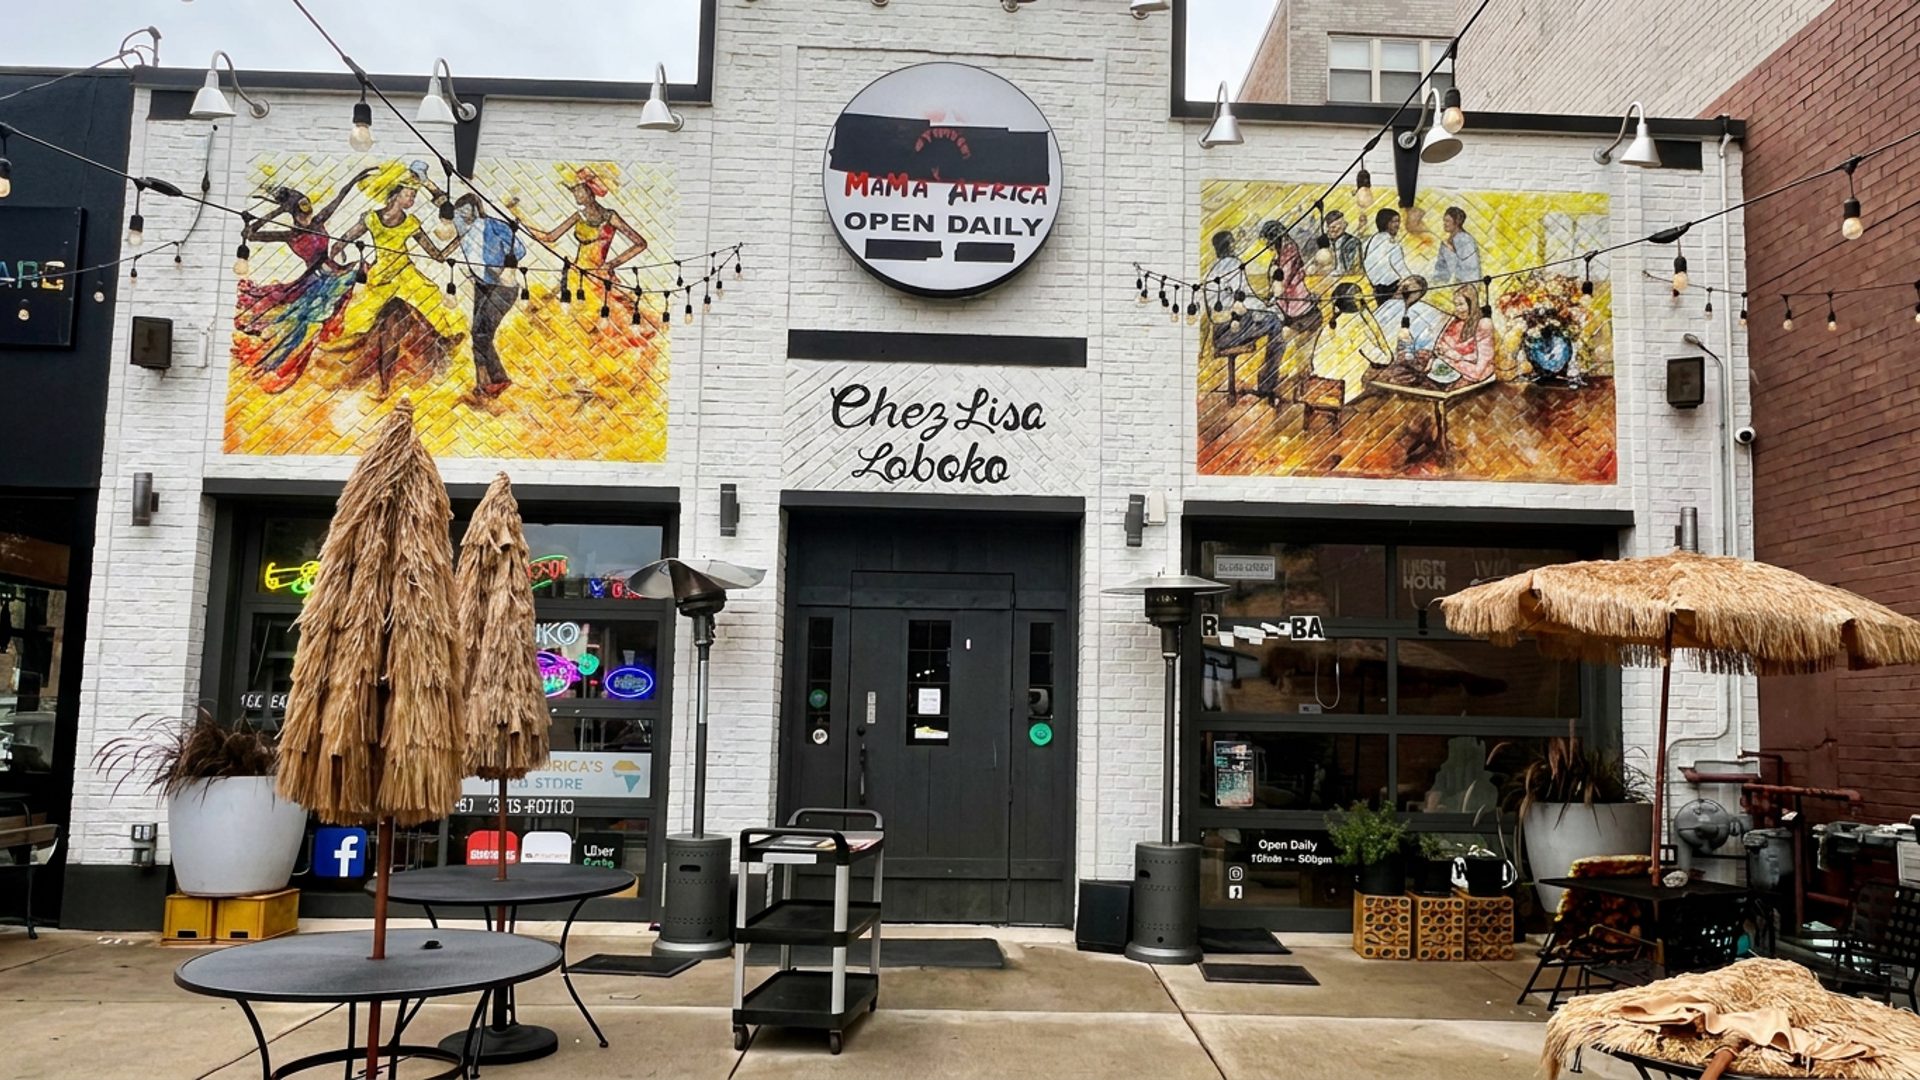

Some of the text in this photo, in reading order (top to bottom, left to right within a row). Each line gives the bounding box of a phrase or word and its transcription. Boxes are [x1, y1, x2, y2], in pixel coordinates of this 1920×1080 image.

[947, 178, 1048, 206] AFRICA
[844, 211, 1044, 237] OPEN DAILY
[830, 383, 1047, 442] Chez Lisa
[851, 442, 1011, 484] Loboko
[1258, 839, 1317, 851] Open Daily
